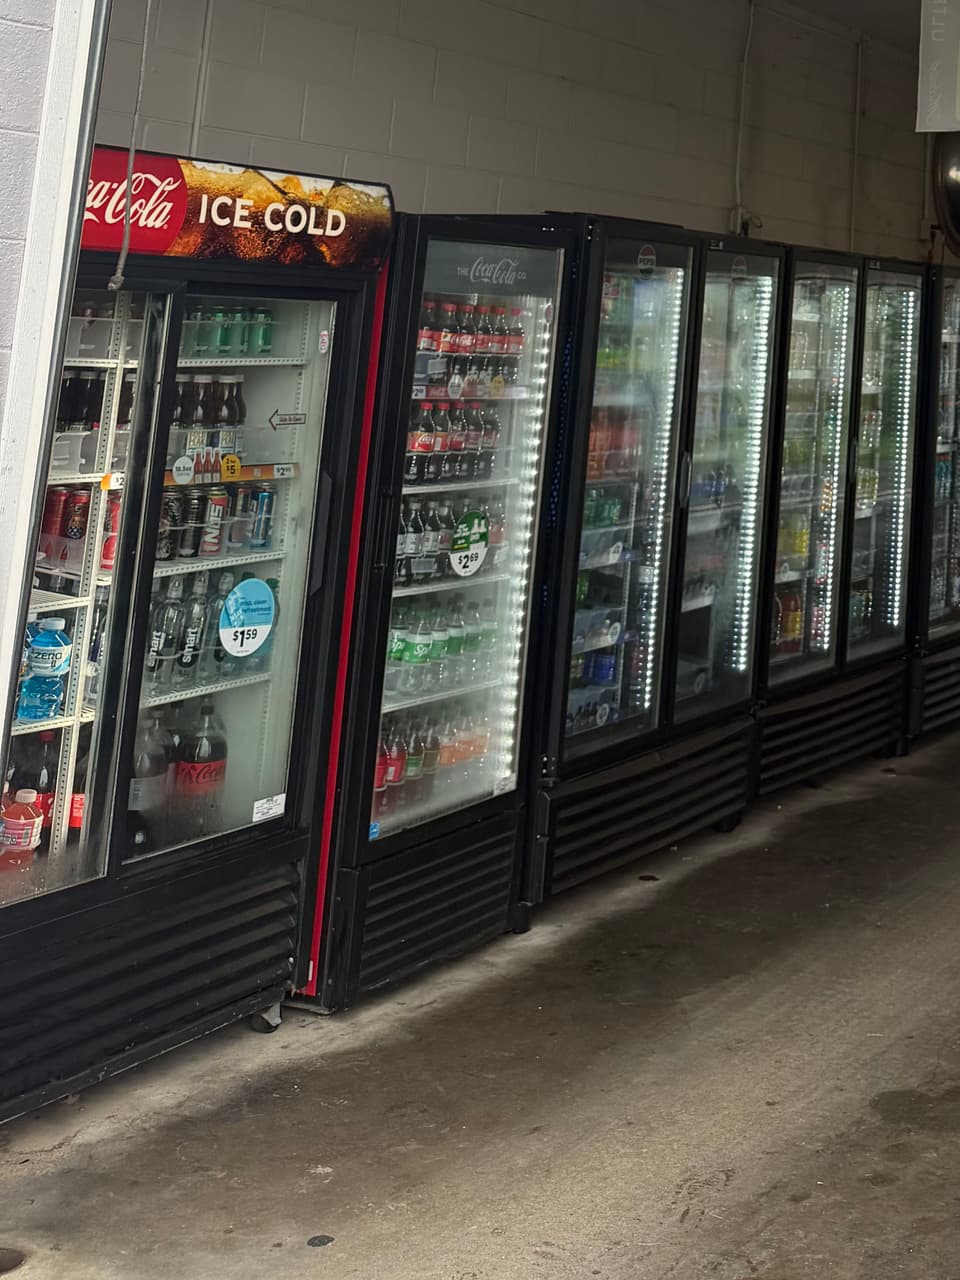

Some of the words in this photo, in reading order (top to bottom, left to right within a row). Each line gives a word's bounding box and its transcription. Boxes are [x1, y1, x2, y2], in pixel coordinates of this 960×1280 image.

[199, 193, 254, 228] ICE
[263, 201, 347, 238] COLD
[470, 256, 519, 285] Coca-Cola
